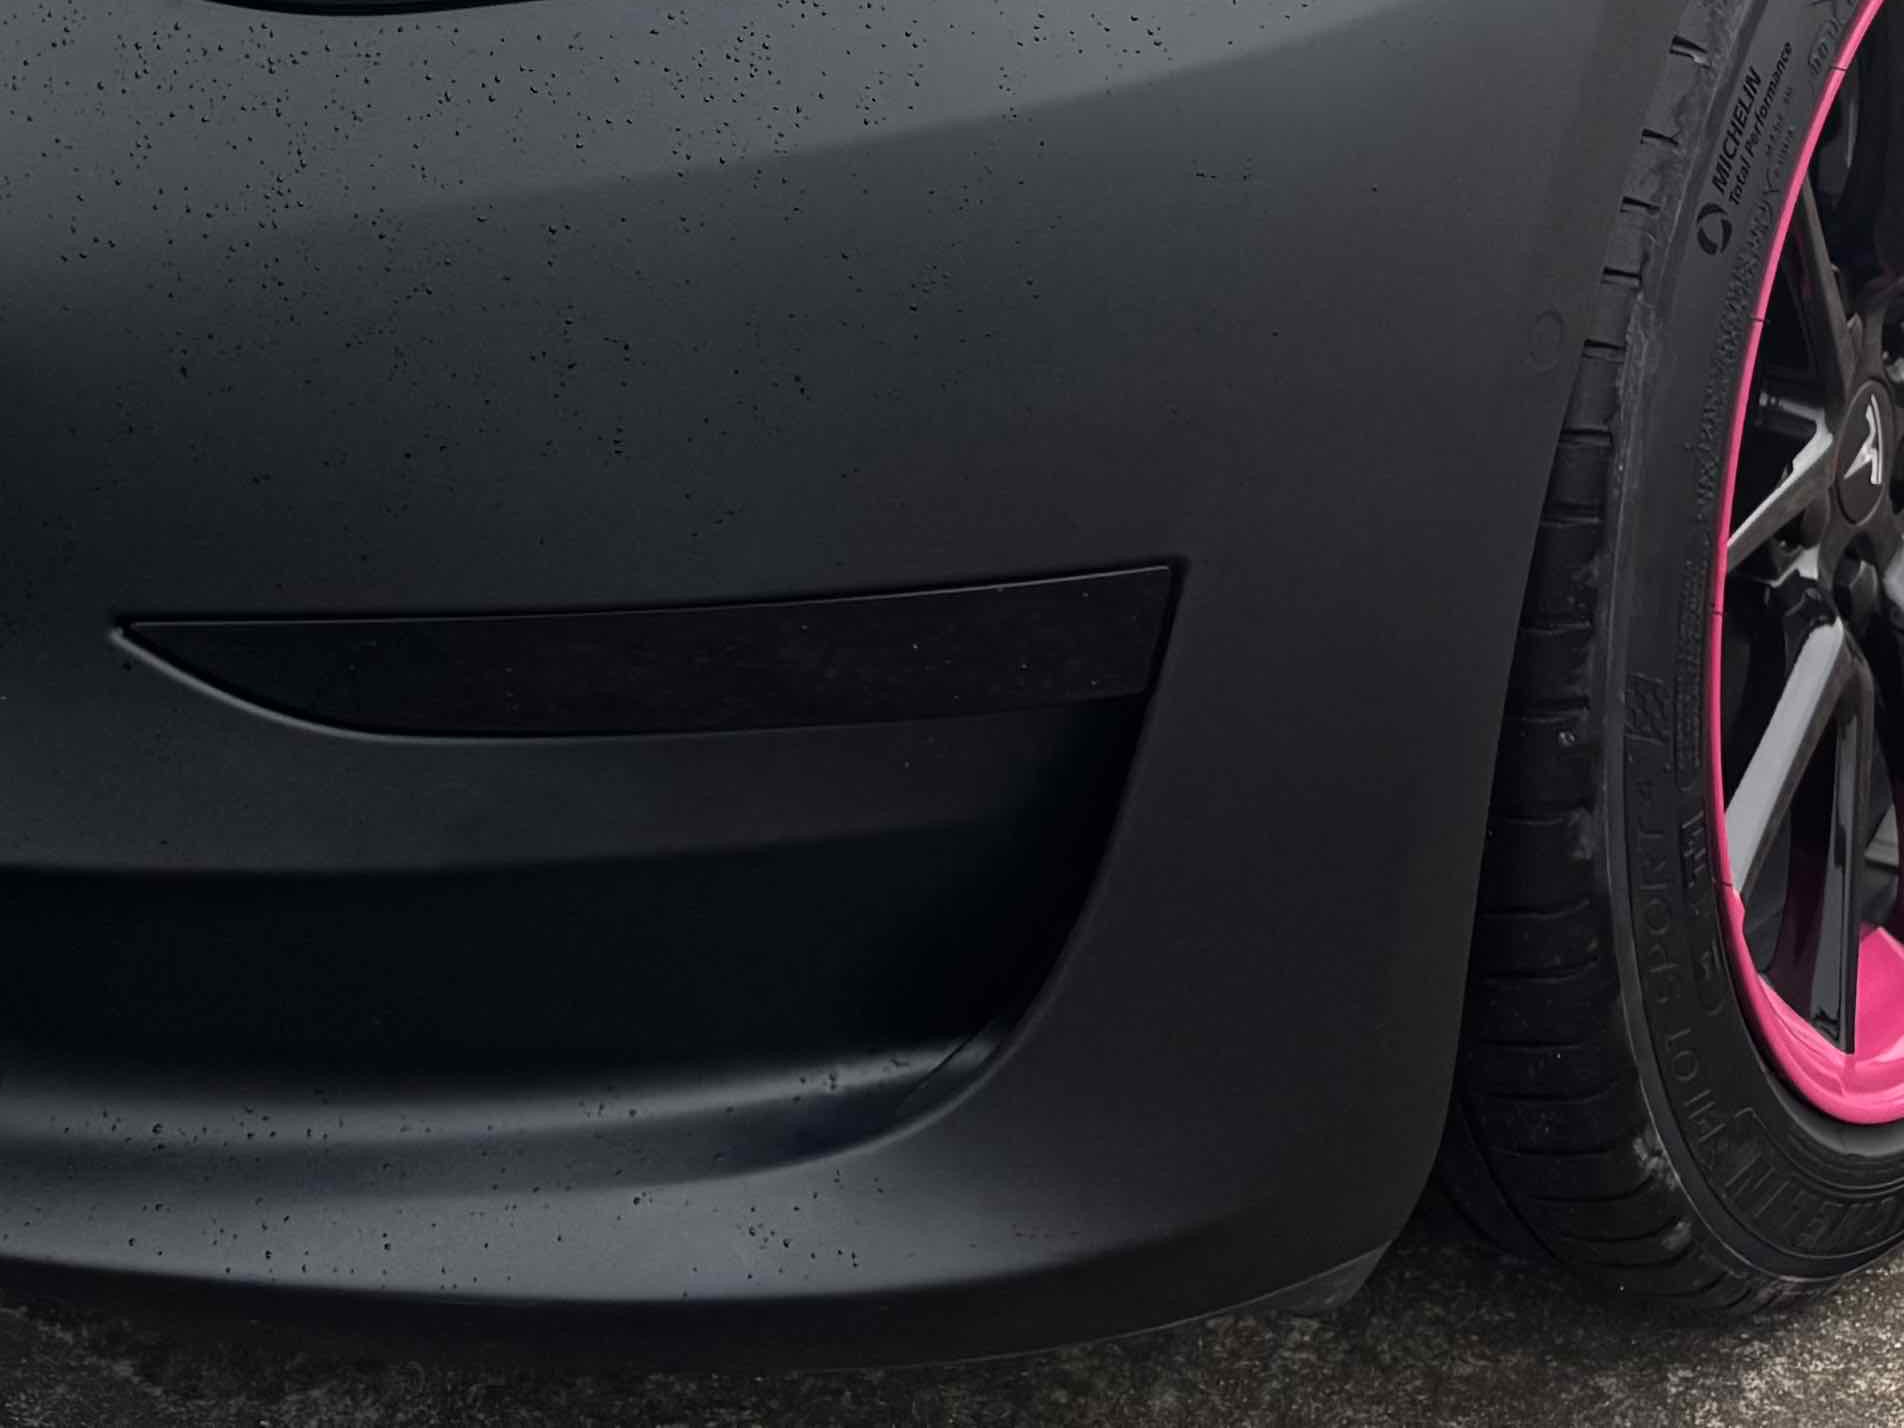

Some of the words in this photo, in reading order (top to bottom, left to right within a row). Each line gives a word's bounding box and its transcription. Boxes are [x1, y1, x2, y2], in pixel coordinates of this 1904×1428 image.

[1712, 66, 1761, 194] MICHELIN
[1729, 156, 1752, 205] Total
[1745, 42, 1791, 158] Performance
[1637, 814, 1679, 1006] SPORT
